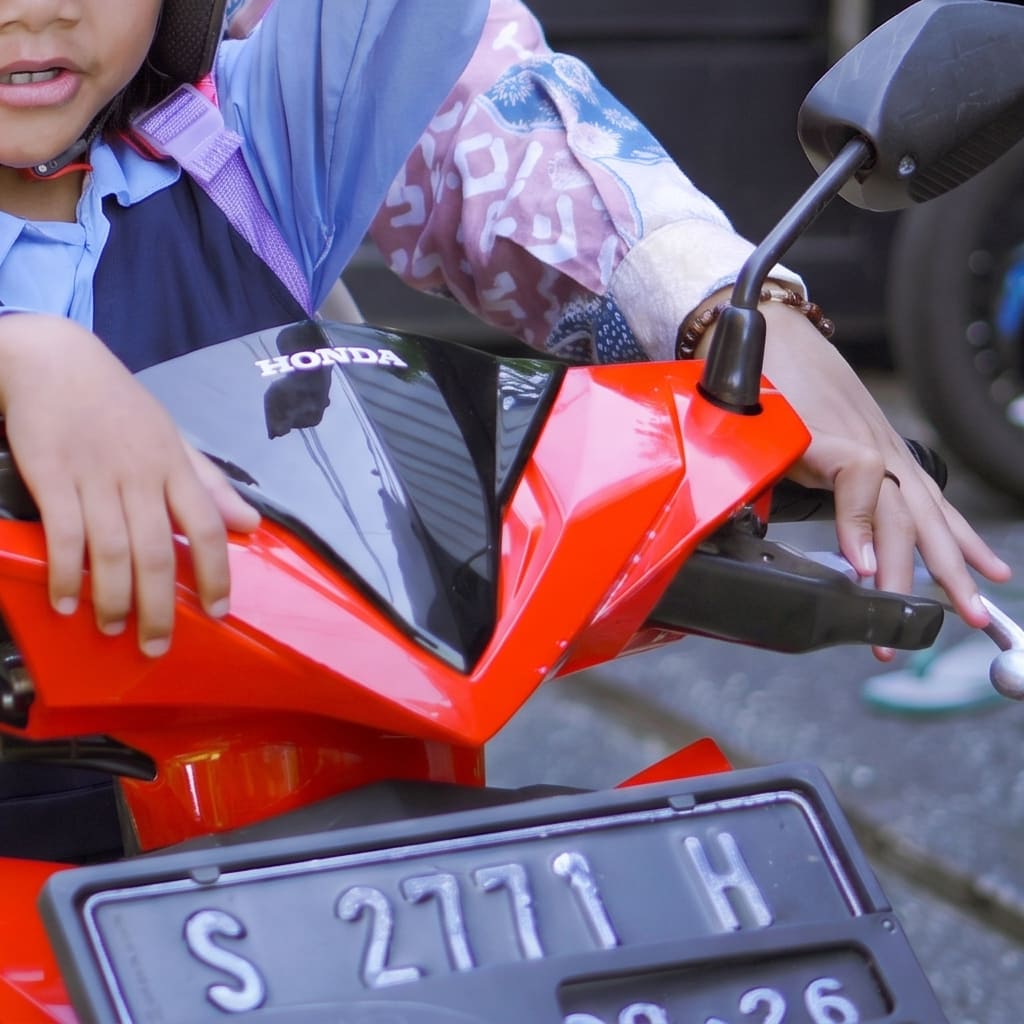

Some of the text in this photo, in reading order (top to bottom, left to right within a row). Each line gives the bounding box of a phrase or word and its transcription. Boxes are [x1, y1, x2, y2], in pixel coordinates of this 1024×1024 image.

[254, 347, 409, 376] HONDA
[184, 908, 266, 1013] S
[335, 851, 621, 989] 2771
[683, 831, 774, 932] H
